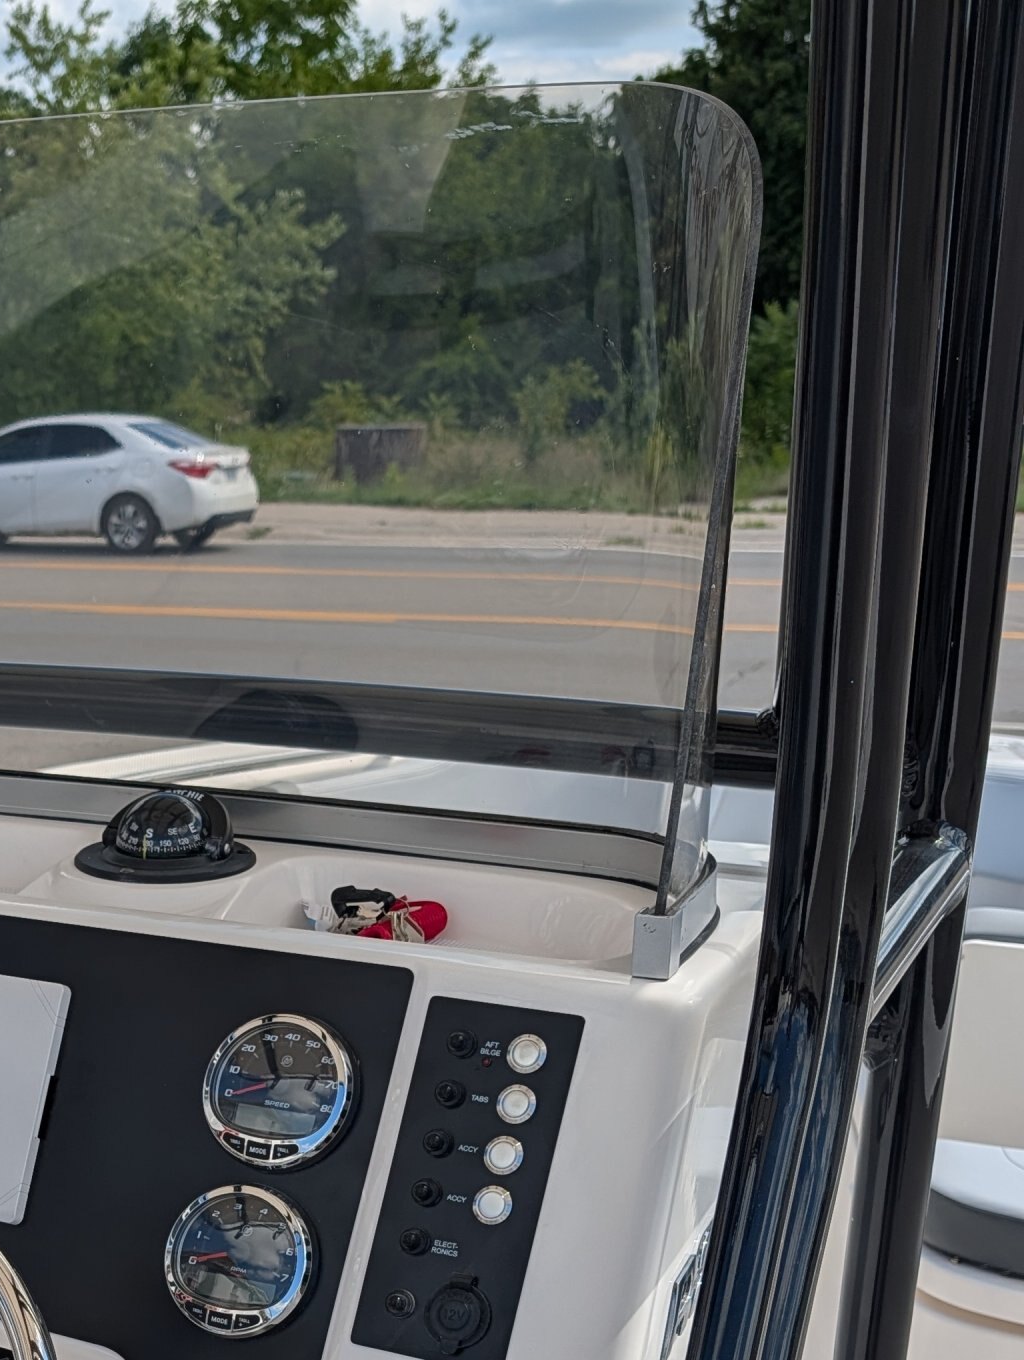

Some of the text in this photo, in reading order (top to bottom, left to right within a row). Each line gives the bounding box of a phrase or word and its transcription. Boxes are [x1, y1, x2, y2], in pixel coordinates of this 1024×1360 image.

[146, 822, 198, 838] S SE E
[262, 1033, 278, 1042] 30
[284, 1032, 301, 1042] 40
[241, 1043, 256, 1053] 20
[305, 1039, 321, 1049] 50
[485, 1041, 500, 1049] AFT
[479, 1047, 502, 1057] BILGE
[321, 1056, 335, 1065] 60
[229, 1065, 240, 1074] 10
[324, 1081, 338, 1090] 70
[224, 1088, 233, 1097] 0
[471, 1094, 489, 1103] TABS
[263, 1099, 290, 1109] SPEED
[249, 1146, 267, 1156] MODE
[458, 1144, 479, 1153] ACCY
[446, 1194, 467, 1203] ACCY
[196, 1231, 202, 1239] 1
[285, 1247, 294, 1256] 6
[431, 1247, 458, 1257] RONICS
[230, 1265, 247, 1274] RPM
[280, 1273, 289, 1283] 7
[210, 1316, 228, 1326] MODE
